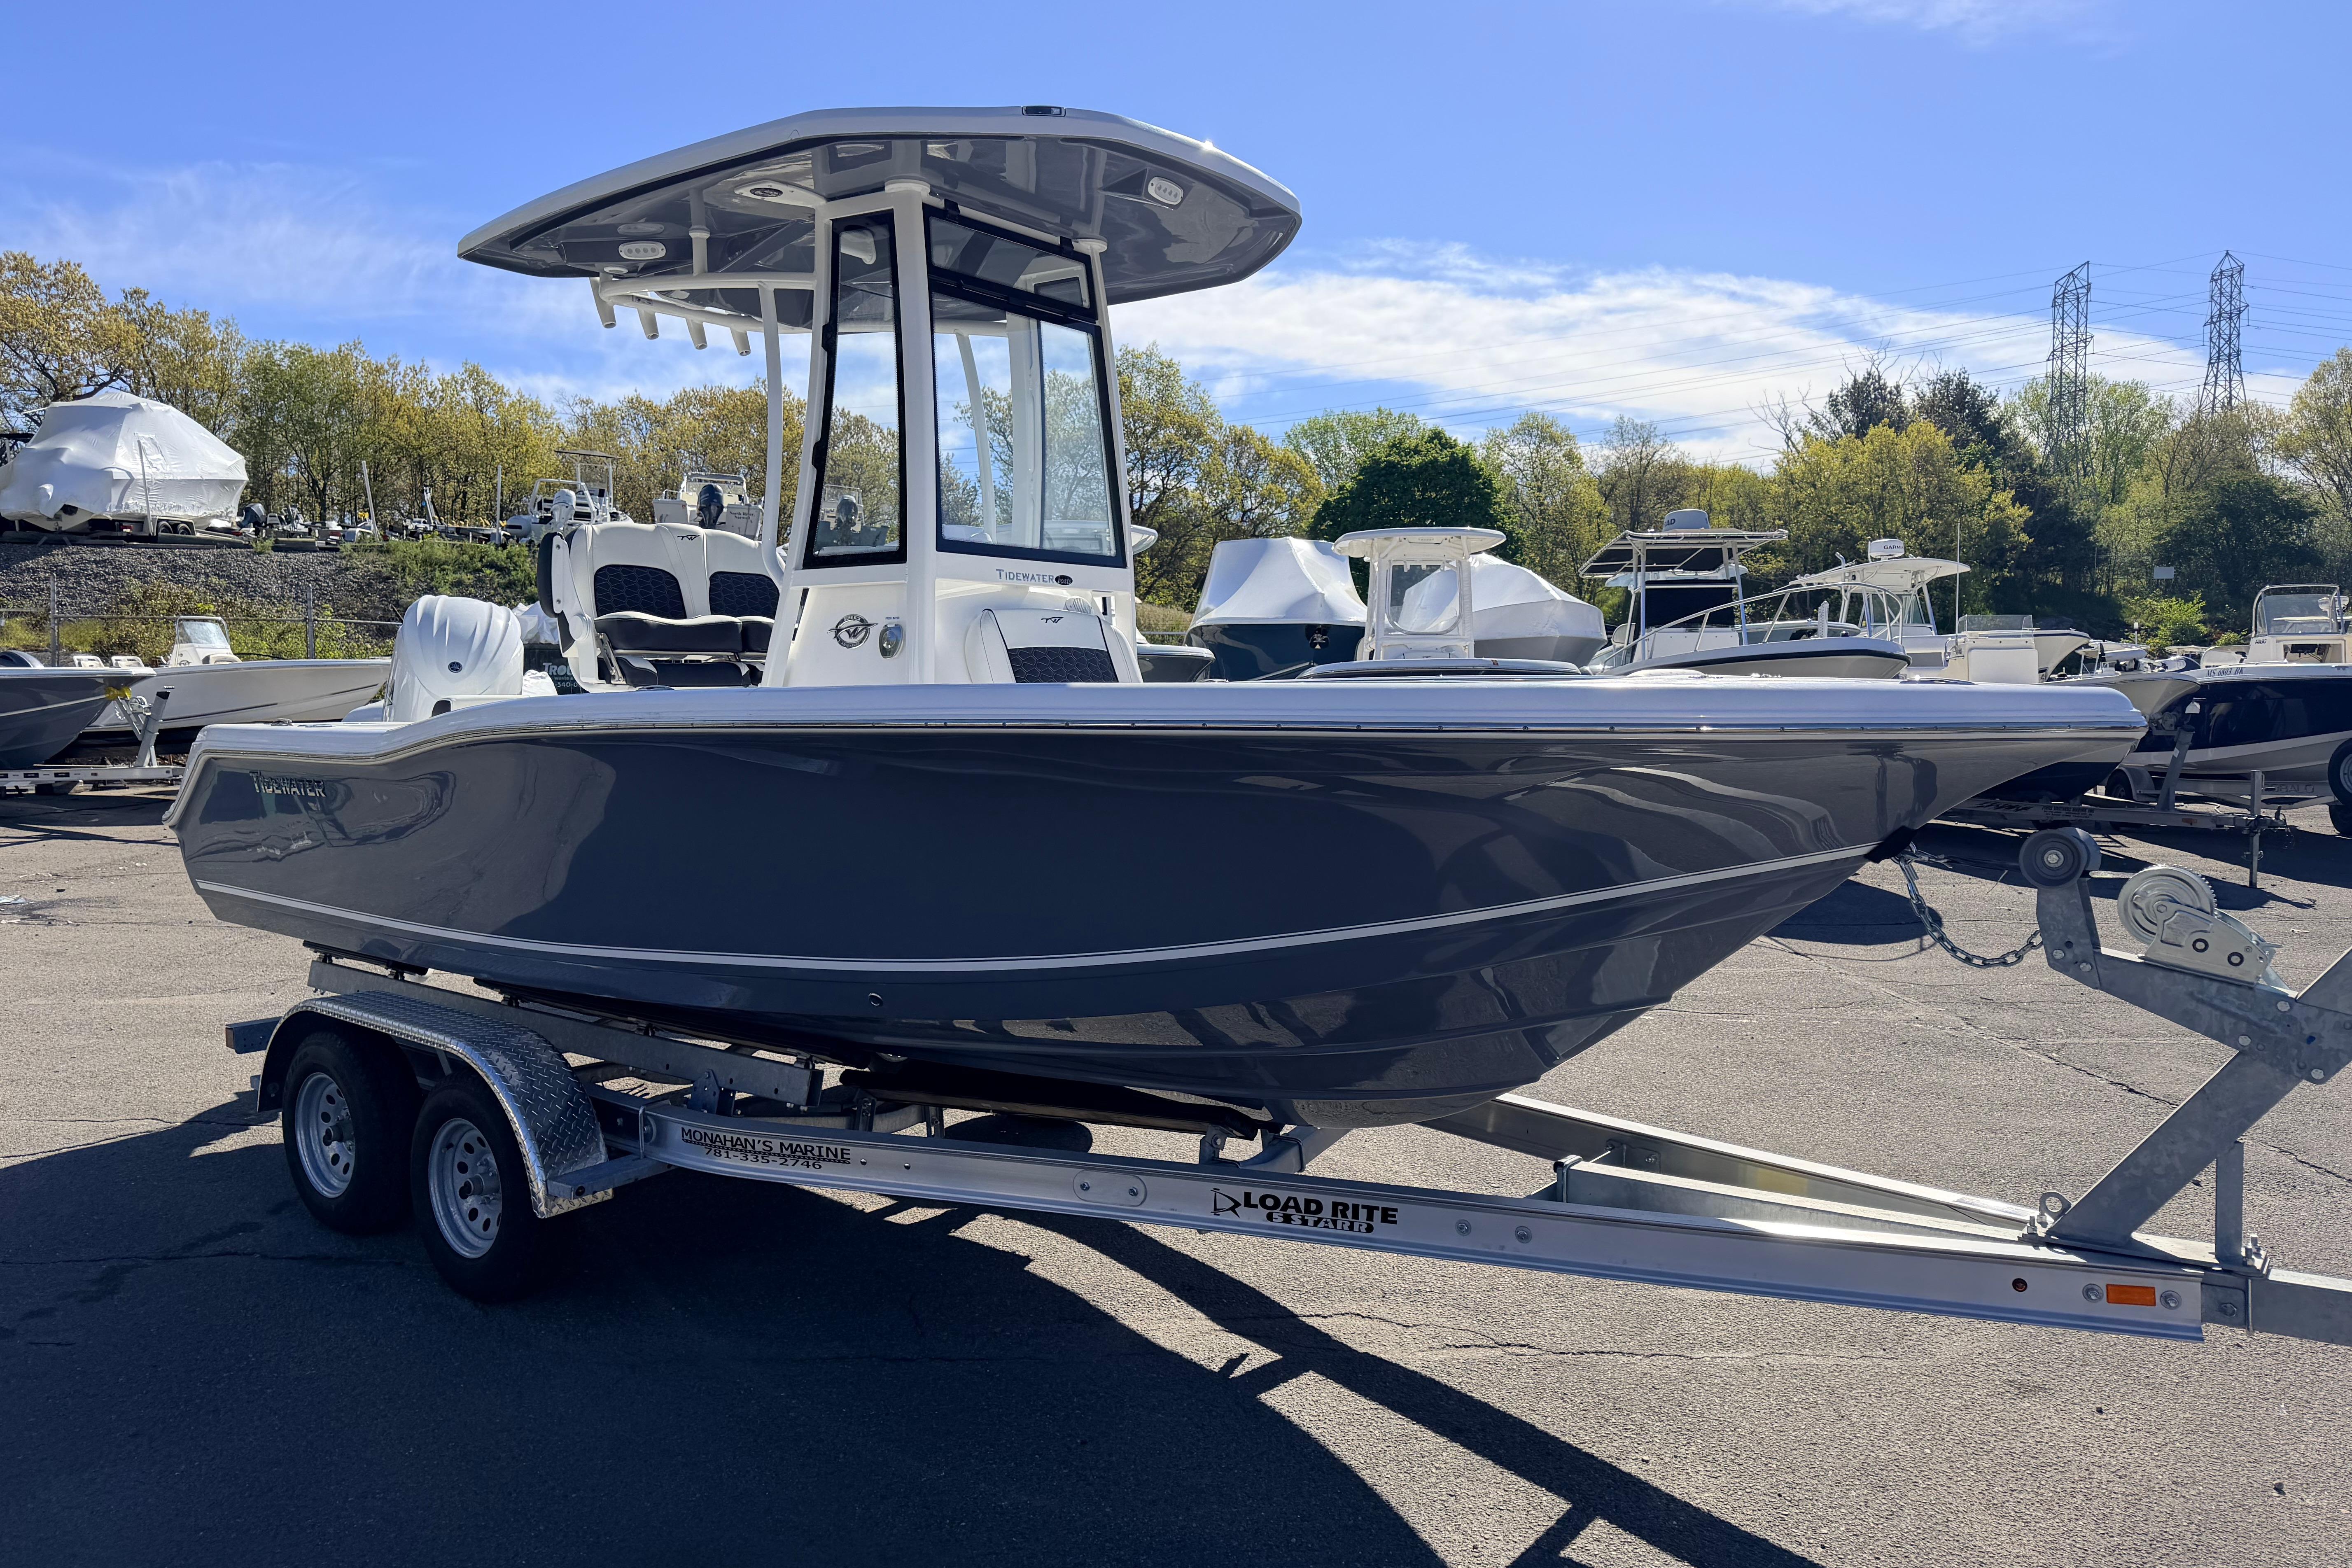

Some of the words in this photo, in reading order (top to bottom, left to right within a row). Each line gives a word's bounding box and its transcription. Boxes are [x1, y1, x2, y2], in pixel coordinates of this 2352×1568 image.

[996, 569, 1054, 583] TIDEWATER
[681, 1127, 773, 1152] MONAHAN'S
[780, 1141, 851, 1160] MARINE
[705, 1147, 822, 1169] 781-335-2746
[1244, 1192, 1323, 1215] LOAD
[1331, 1201, 1398, 1225] RITE
[1272, 1213, 1284, 1223] 5
[1290, 1214, 1368, 1233] STARR
